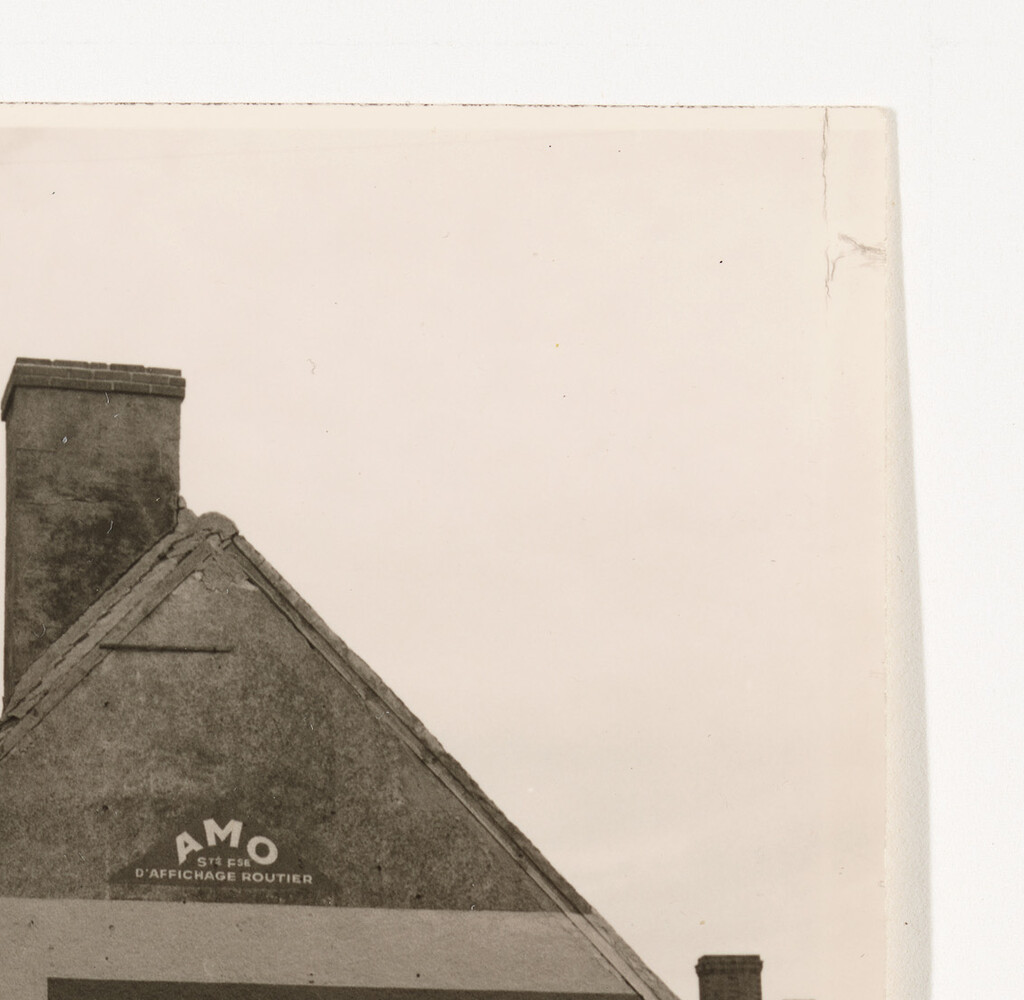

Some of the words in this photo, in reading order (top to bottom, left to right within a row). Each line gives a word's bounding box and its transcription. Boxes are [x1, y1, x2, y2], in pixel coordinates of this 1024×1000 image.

[176, 818, 278, 865] AMO
[135, 868, 236, 881] D'AFFICHAGE
[241, 872, 313, 884] ROUTIER
